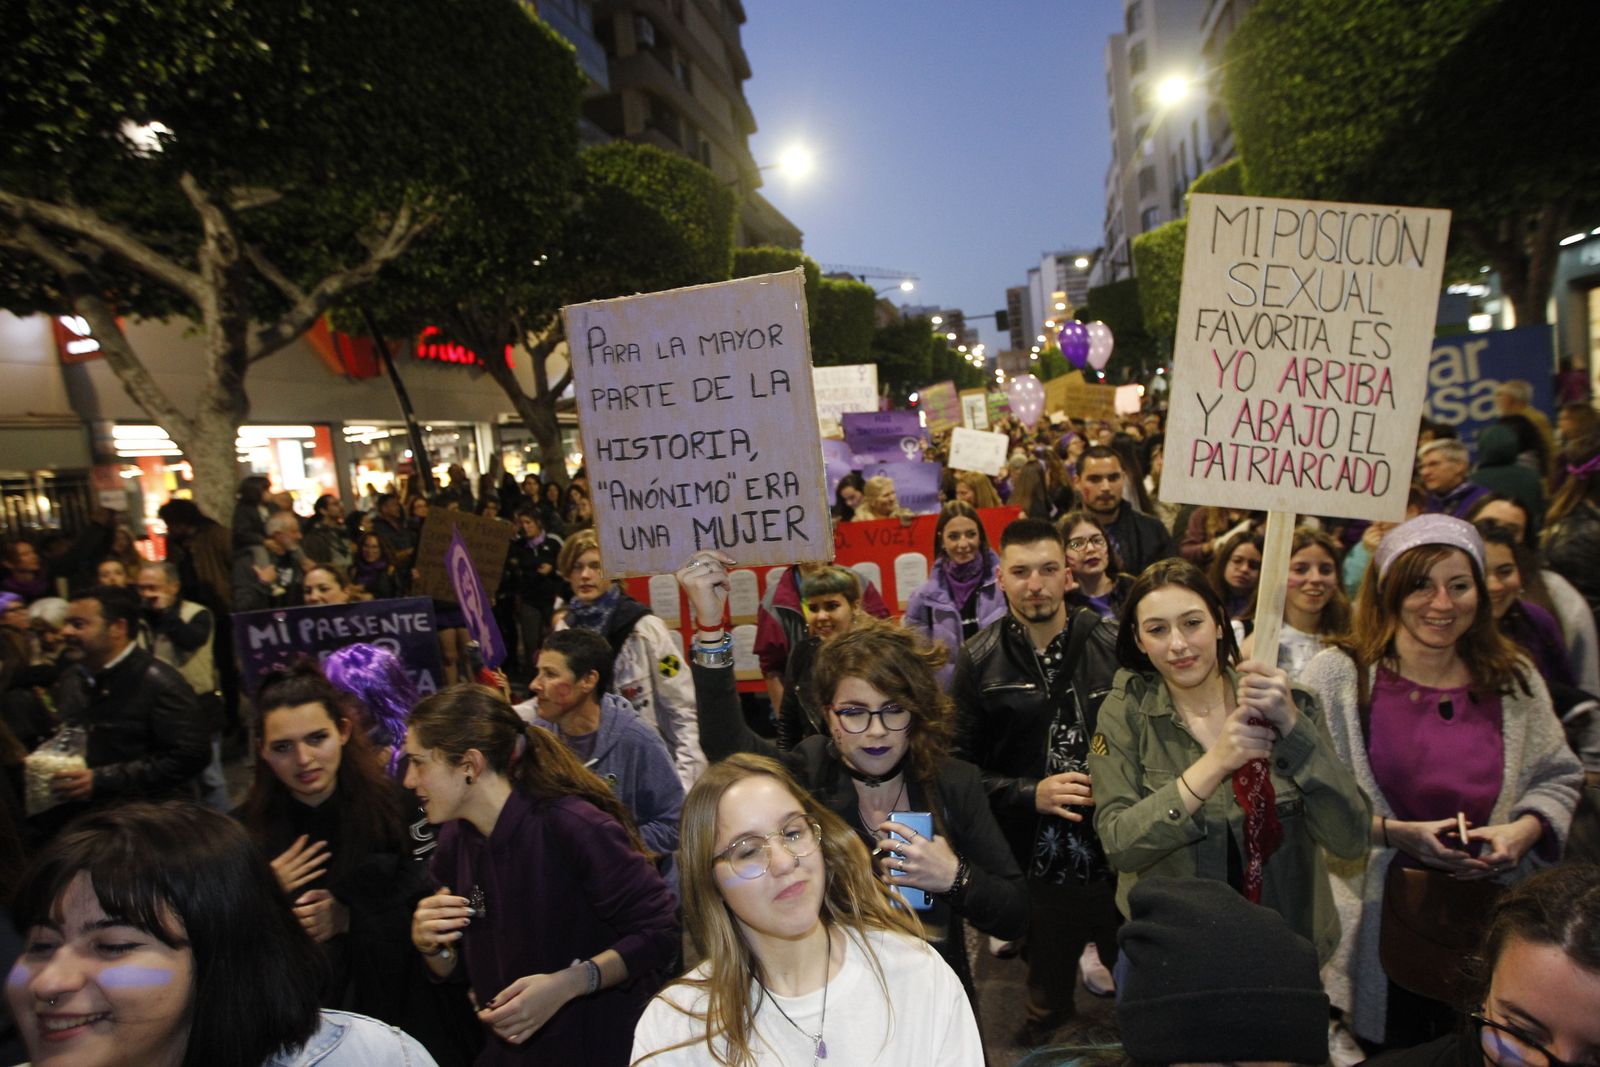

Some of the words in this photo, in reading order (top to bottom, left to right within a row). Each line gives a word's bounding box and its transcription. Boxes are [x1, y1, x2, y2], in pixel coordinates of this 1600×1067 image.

[1212, 206, 1264, 257] MI
[1272, 208, 1430, 268] POSICIÓN
[1227, 263, 1383, 315] SEXUAL
[588, 327, 641, 366] PARA
[657, 337, 685, 359] LA
[699, 324, 783, 356] MAYOR
[1195, 309, 1331, 353] FAVORITA
[1349, 321, 1392, 360] ES
[591, 382, 676, 411] PARTE
[693, 376, 733, 403] DE
[750, 370, 791, 398] LA
[1212, 350, 1257, 392] YO
[1277, 357, 1396, 409] ARRIBA
[1423, 379, 1503, 426] sa
[597, 429, 758, 461] HISTORIA,
[1197, 392, 1223, 436] Y
[1231, 398, 1339, 449] ABAJO
[1349, 412, 1386, 456] EL
[746, 471, 799, 501] ERA
[1190, 439, 1391, 497] PATRIARCADO
[620, 525, 670, 550] UNA
[692, 506, 809, 550] MUJER
[300, 612, 432, 643] PRESENTE
